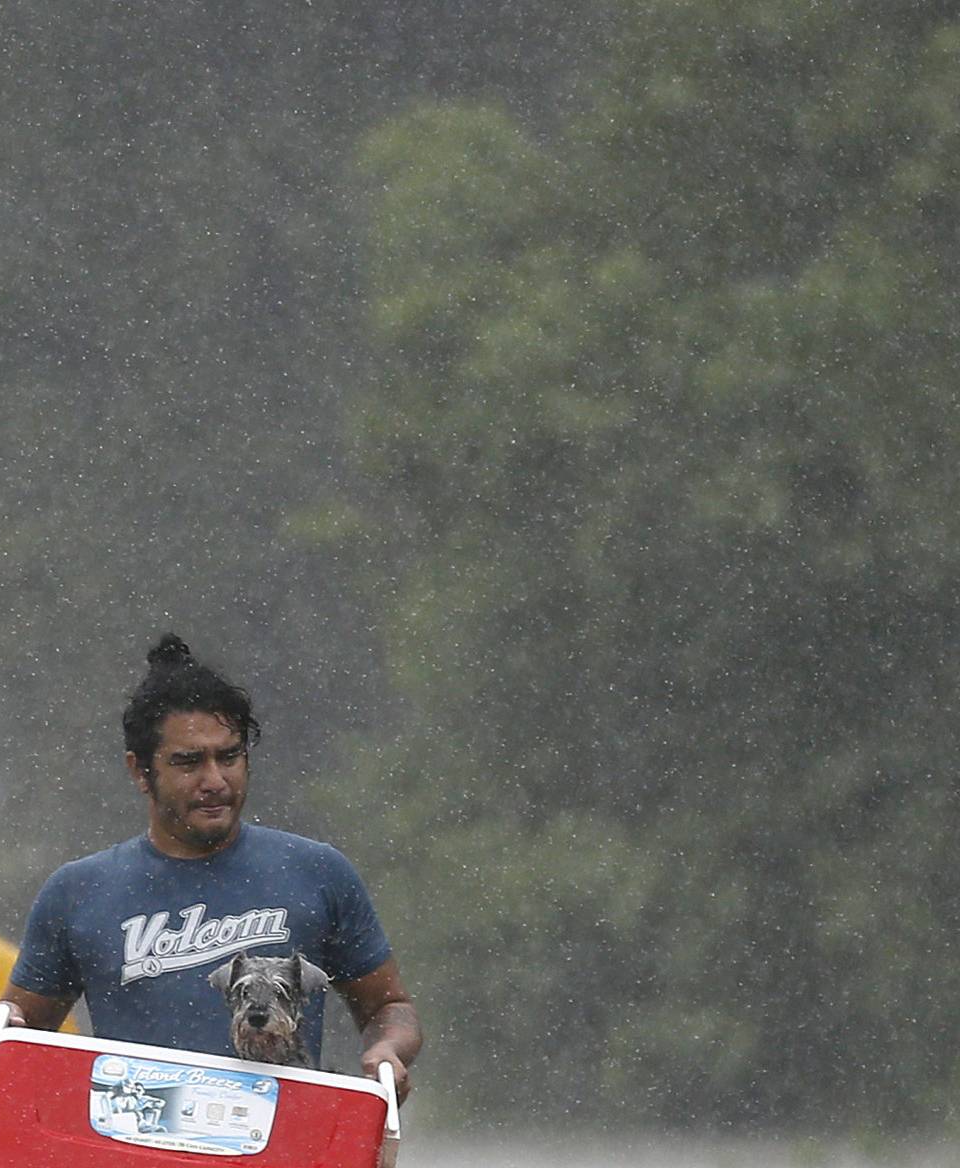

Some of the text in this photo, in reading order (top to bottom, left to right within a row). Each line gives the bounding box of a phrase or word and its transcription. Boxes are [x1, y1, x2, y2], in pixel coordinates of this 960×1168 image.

[121, 903, 289, 965] Volcom
[131, 1065, 243, 1091] Island Breeze
